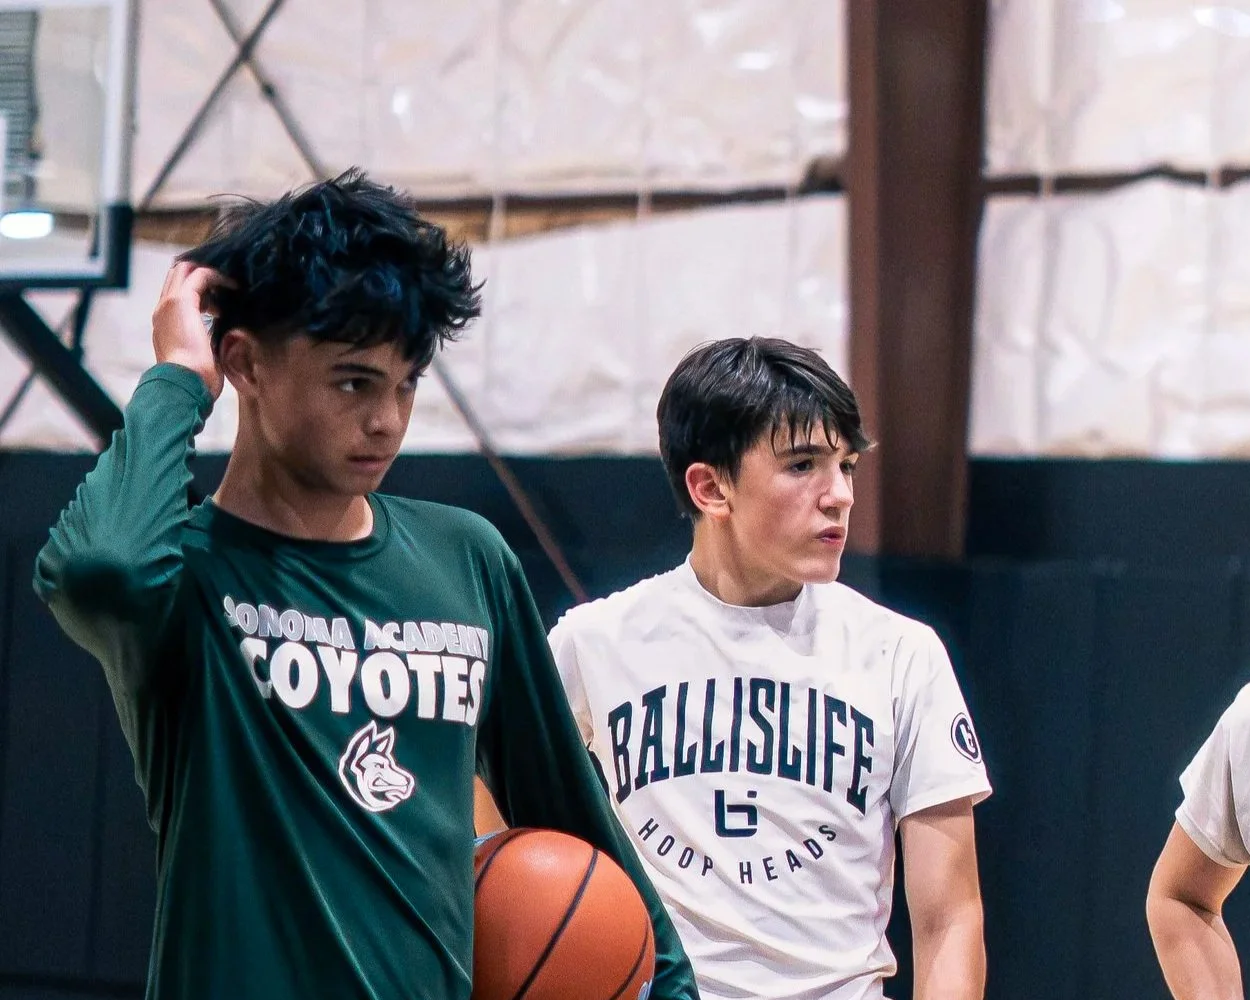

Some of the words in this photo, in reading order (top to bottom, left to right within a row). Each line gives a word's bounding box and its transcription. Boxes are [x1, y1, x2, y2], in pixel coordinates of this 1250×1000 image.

[223, 595, 356, 650] SONOMA
[364, 619, 489, 661] ACADEMY
[240, 637, 487, 726] COYOTES
[607, 677, 875, 817] BALLISLIFE
[637, 817, 714, 876] HOOP
[738, 824, 837, 884] HEADS
